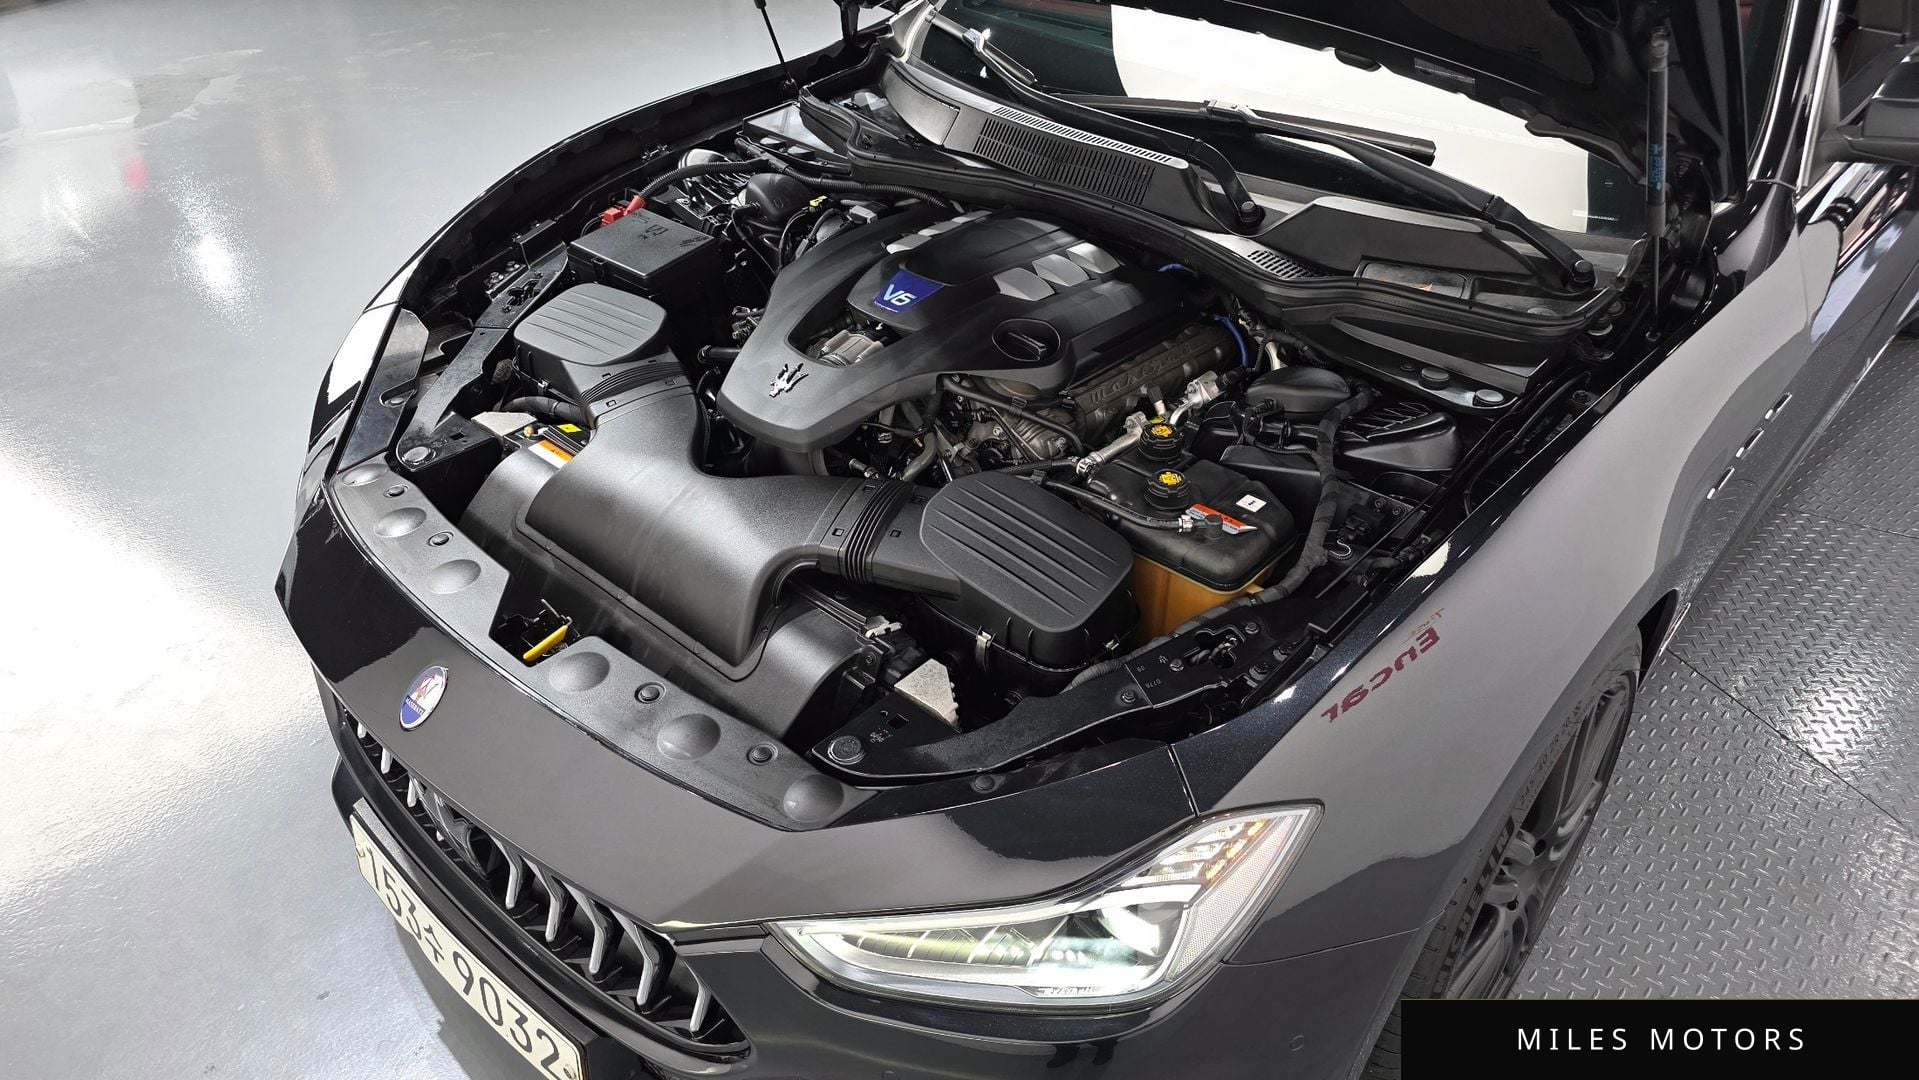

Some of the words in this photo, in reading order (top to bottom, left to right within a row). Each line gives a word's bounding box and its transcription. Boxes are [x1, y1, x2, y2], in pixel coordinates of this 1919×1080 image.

[883, 283, 918, 306] V6
[366, 846, 445, 964] 153수
[452, 950, 562, 1080] 9032
[1433, 824, 1511, 994] MICHELIN
